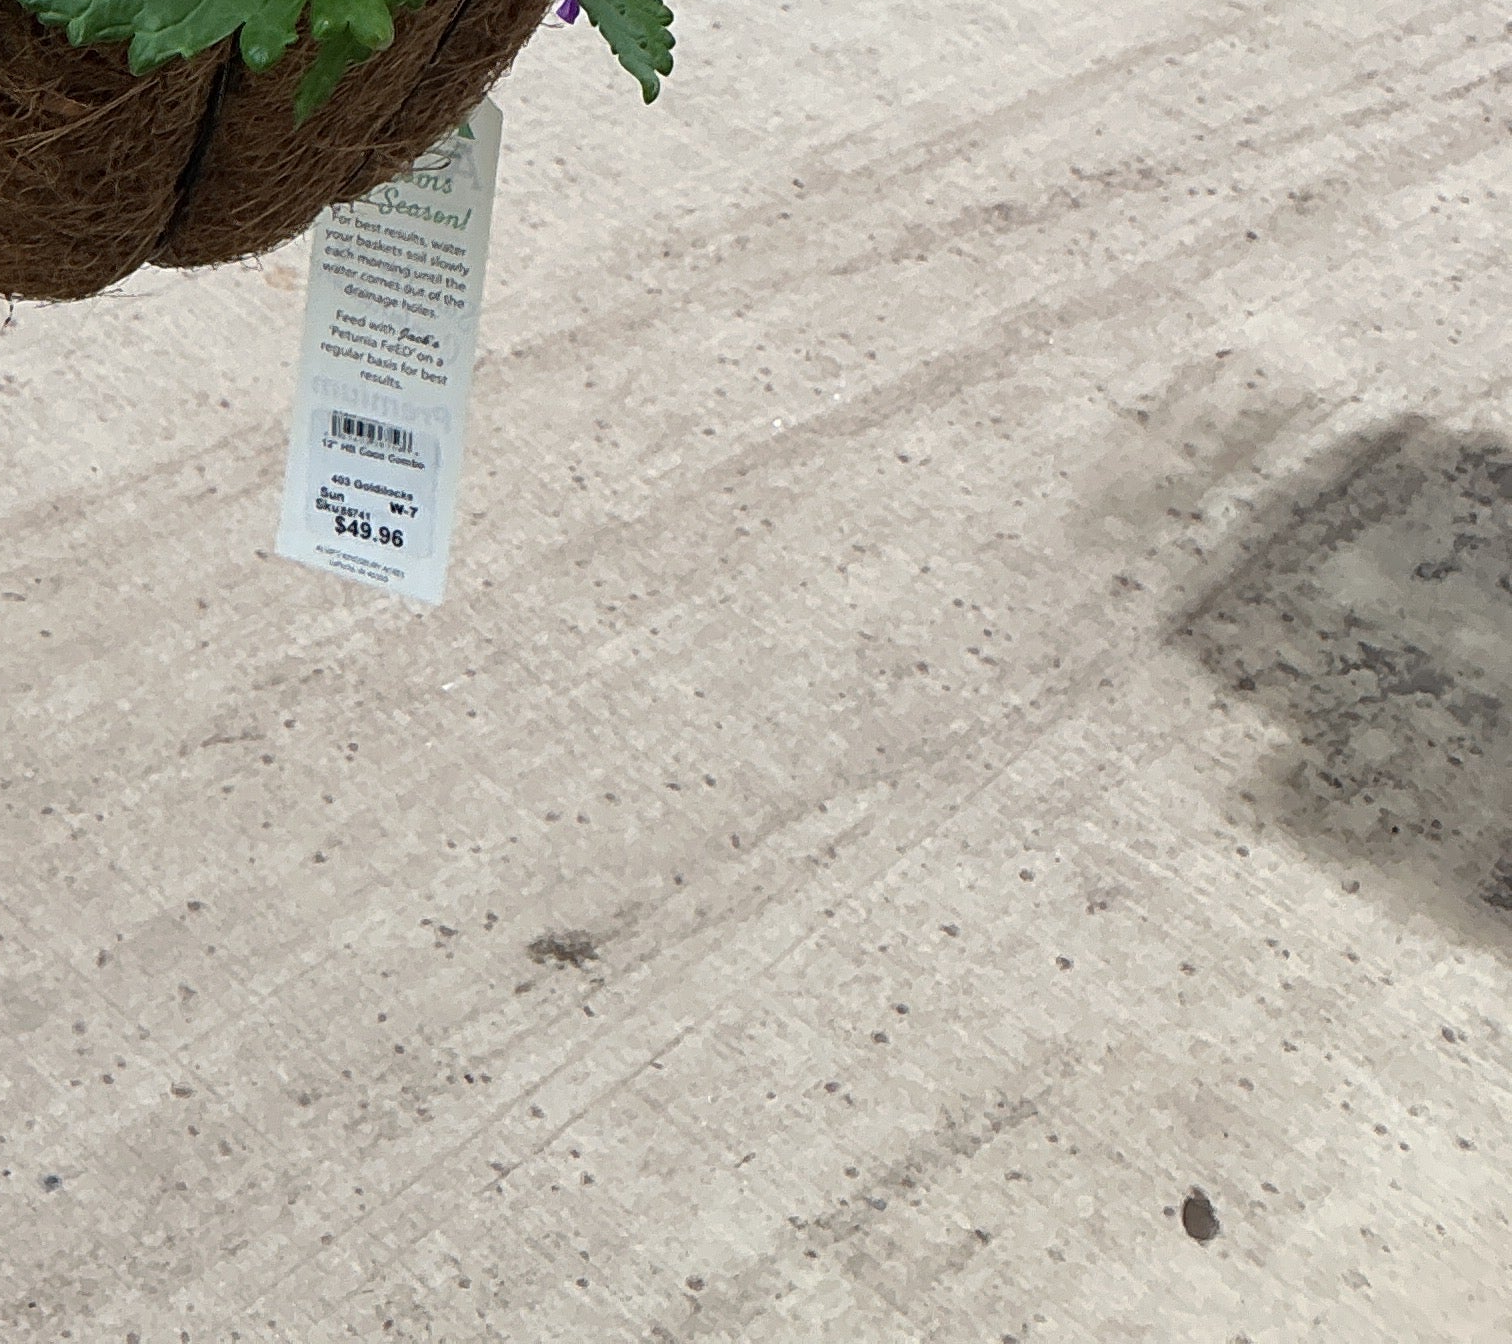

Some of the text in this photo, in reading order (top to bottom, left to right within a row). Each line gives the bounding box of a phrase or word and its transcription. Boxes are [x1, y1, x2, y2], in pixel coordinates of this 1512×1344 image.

[332, 211, 351, 226] For
[355, 217, 381, 233] best
[431, 240, 466, 256] water
[324, 245, 467, 292] each morning until the
[326, 229, 353, 244] your
[356, 235, 402, 256] baskets
[431, 255, 469, 276] slowly
[323, 262, 465, 309] water comes out of the
[344, 284, 398, 308] drainage
[336, 309, 366, 328] Feed
[369, 321, 396, 336] with
[320, 341, 448, 386] regular basis for best
[417, 351, 433, 364] on
[388, 453, 425, 470] Combo
[320, 486, 419, 519] Sun W-7
[354, 479, 414, 501] Goldilocks
[334, 515, 404, 547] $49.96
